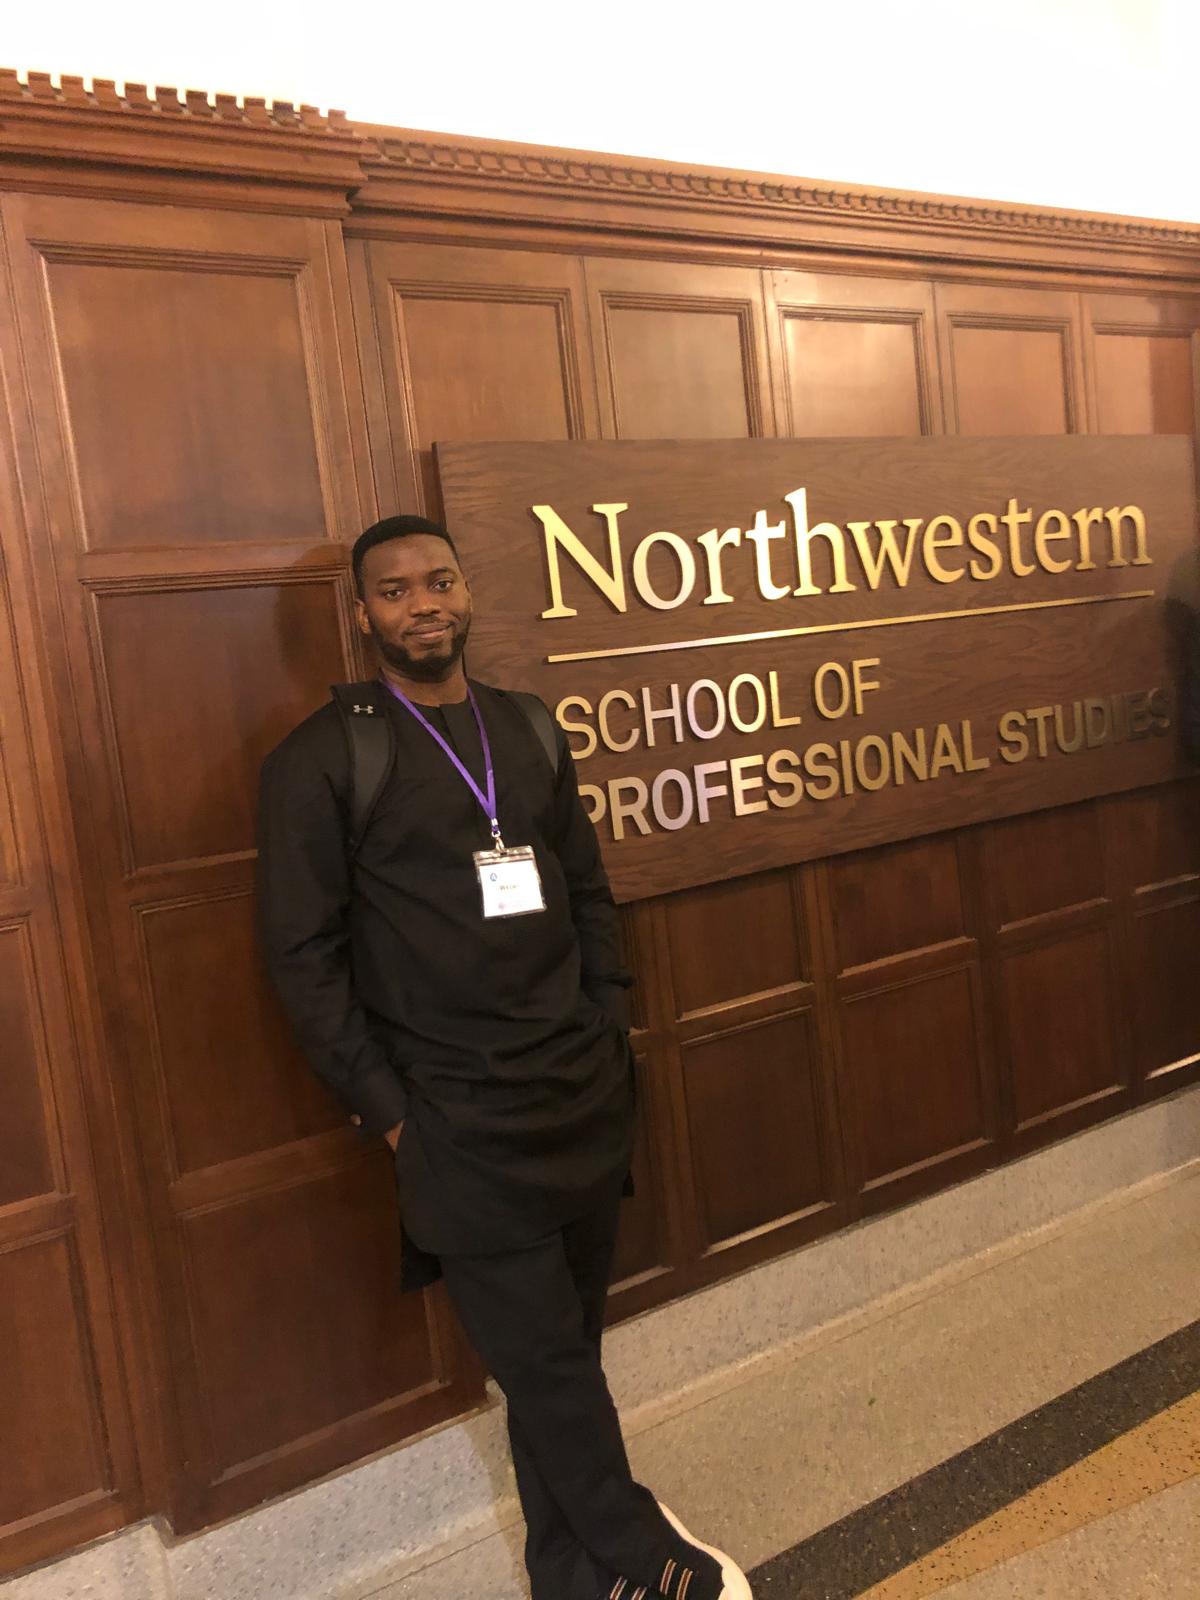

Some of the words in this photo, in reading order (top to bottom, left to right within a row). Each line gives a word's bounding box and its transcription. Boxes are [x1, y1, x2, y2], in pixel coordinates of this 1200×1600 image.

[532, 487, 1153, 619] Northwestern
[555, 671, 801, 760] SCHOOL
[814, 658, 881, 720] OF
[999, 688, 1171, 764] STUDIES
